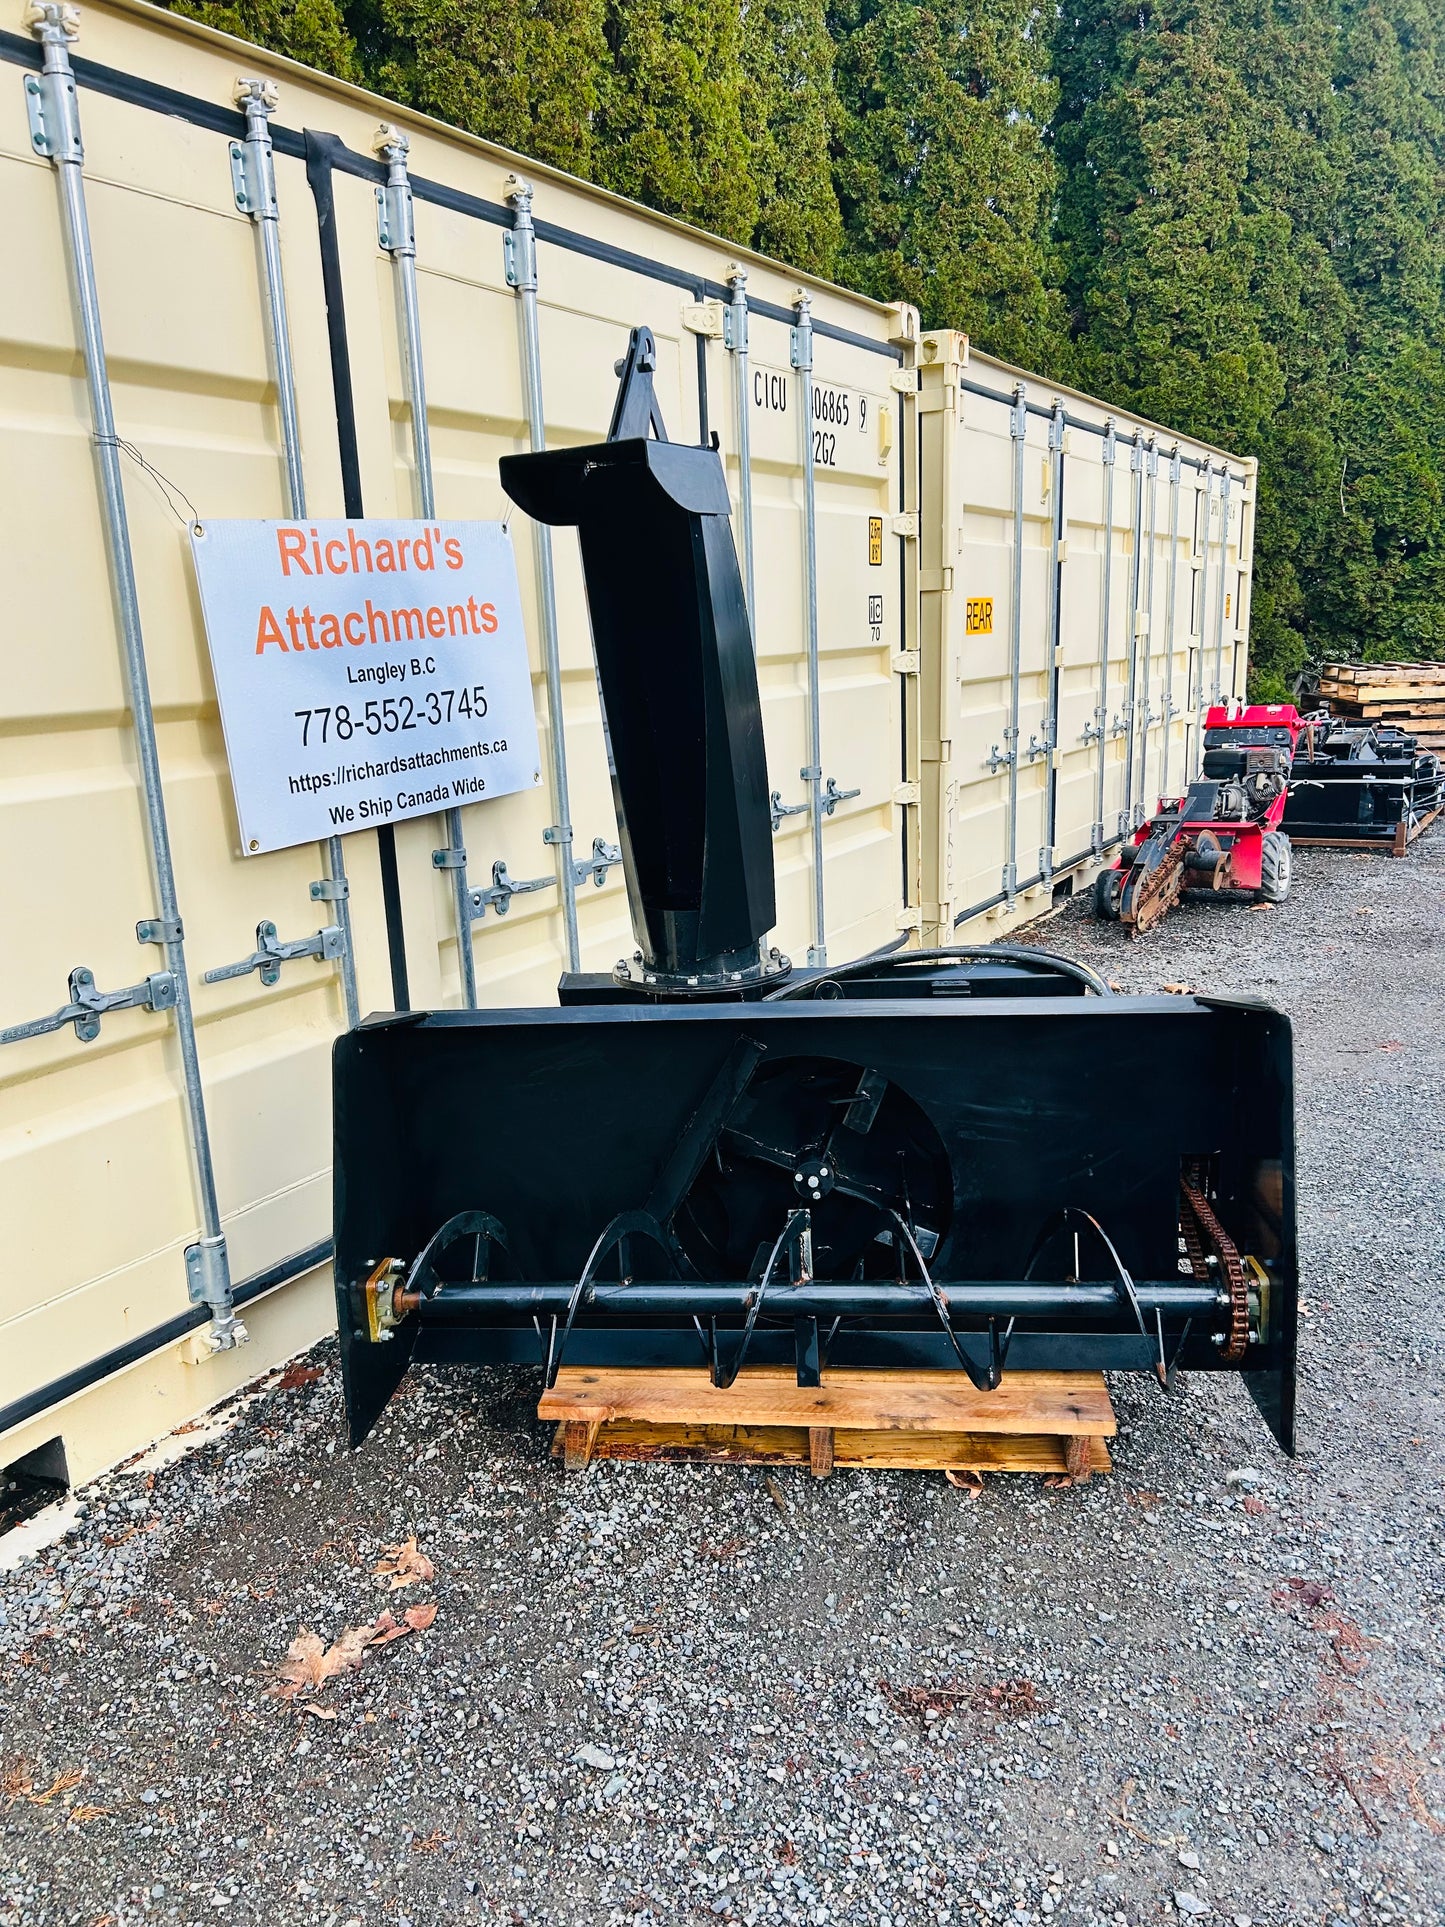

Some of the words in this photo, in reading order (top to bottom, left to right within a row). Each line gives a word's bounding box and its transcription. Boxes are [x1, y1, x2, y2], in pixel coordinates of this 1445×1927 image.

[754, 371, 787, 412] CICU
[811, 386, 849, 426] 06865
[860, 398, 866, 429] 9
[812, 430, 836, 466] 2G2
[276, 528, 464, 576] Richard's
[255, 596, 499, 655] Attachments
[871, 626, 881, 641] 70
[966, 602, 993, 630] REAR
[347, 661, 406, 684] Langley
[411, 656, 436, 676] B.C
[294, 685, 488, 747] 778-552-3745
[288, 739, 508, 794] https://richardsattachments.ca
[329, 805, 355, 825] We
[358, 797, 393, 818] Ship
[397, 784, 450, 810] Canada
[452, 776, 486, 797] Wide
